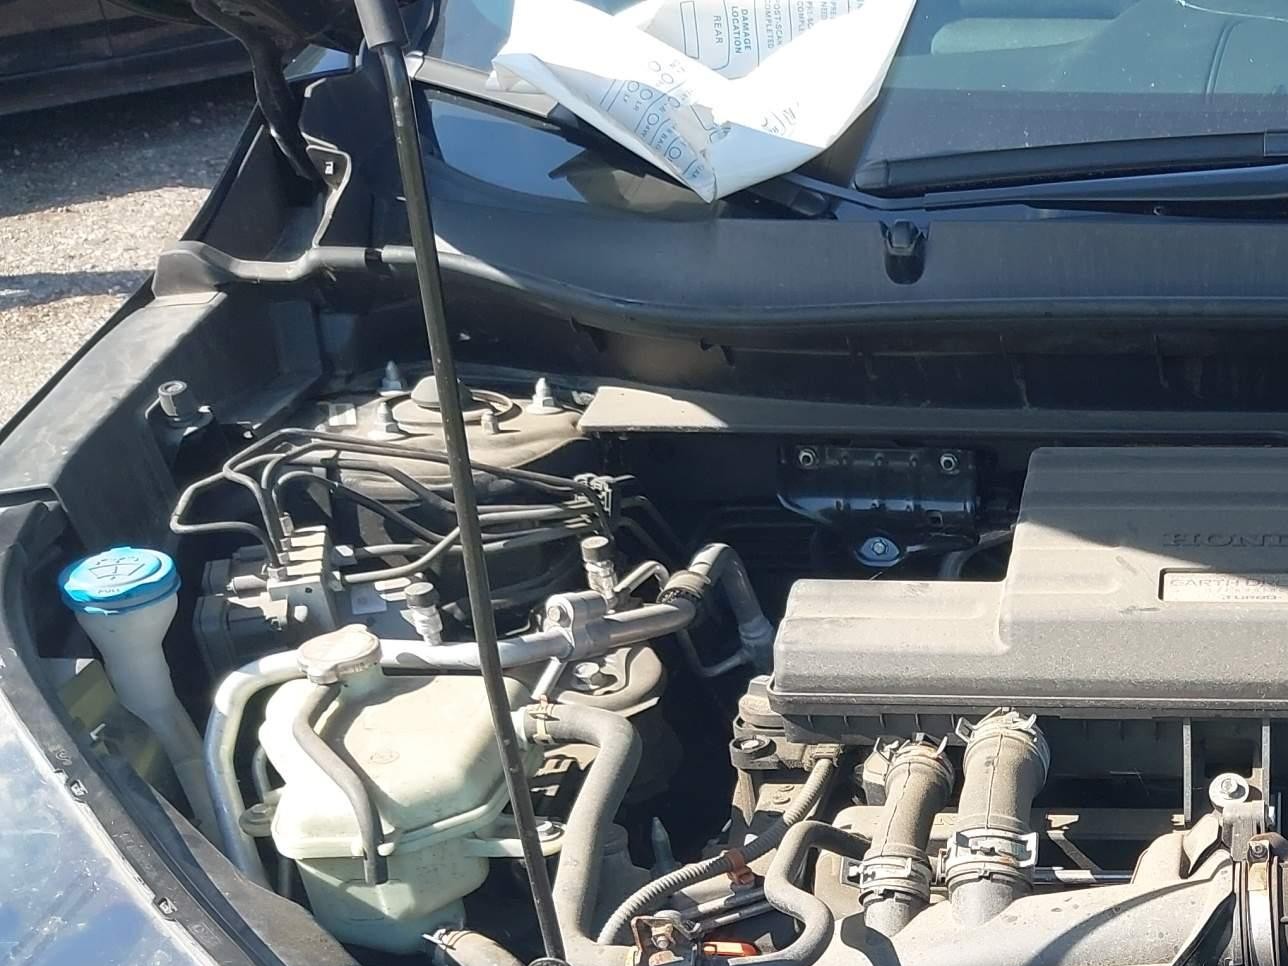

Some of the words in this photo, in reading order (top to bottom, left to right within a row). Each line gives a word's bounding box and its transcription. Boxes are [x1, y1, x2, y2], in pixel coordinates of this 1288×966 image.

[713, 15, 724, 45] REAR
[731, 6, 743, 54] LOCATION
[741, 8, 752, 51] DAMAGE
[764, 0, 775, 49] OMPLETED
[773, 0, 784, 46] OST-SCAN
[1169, 578, 1240, 587] EARTH
